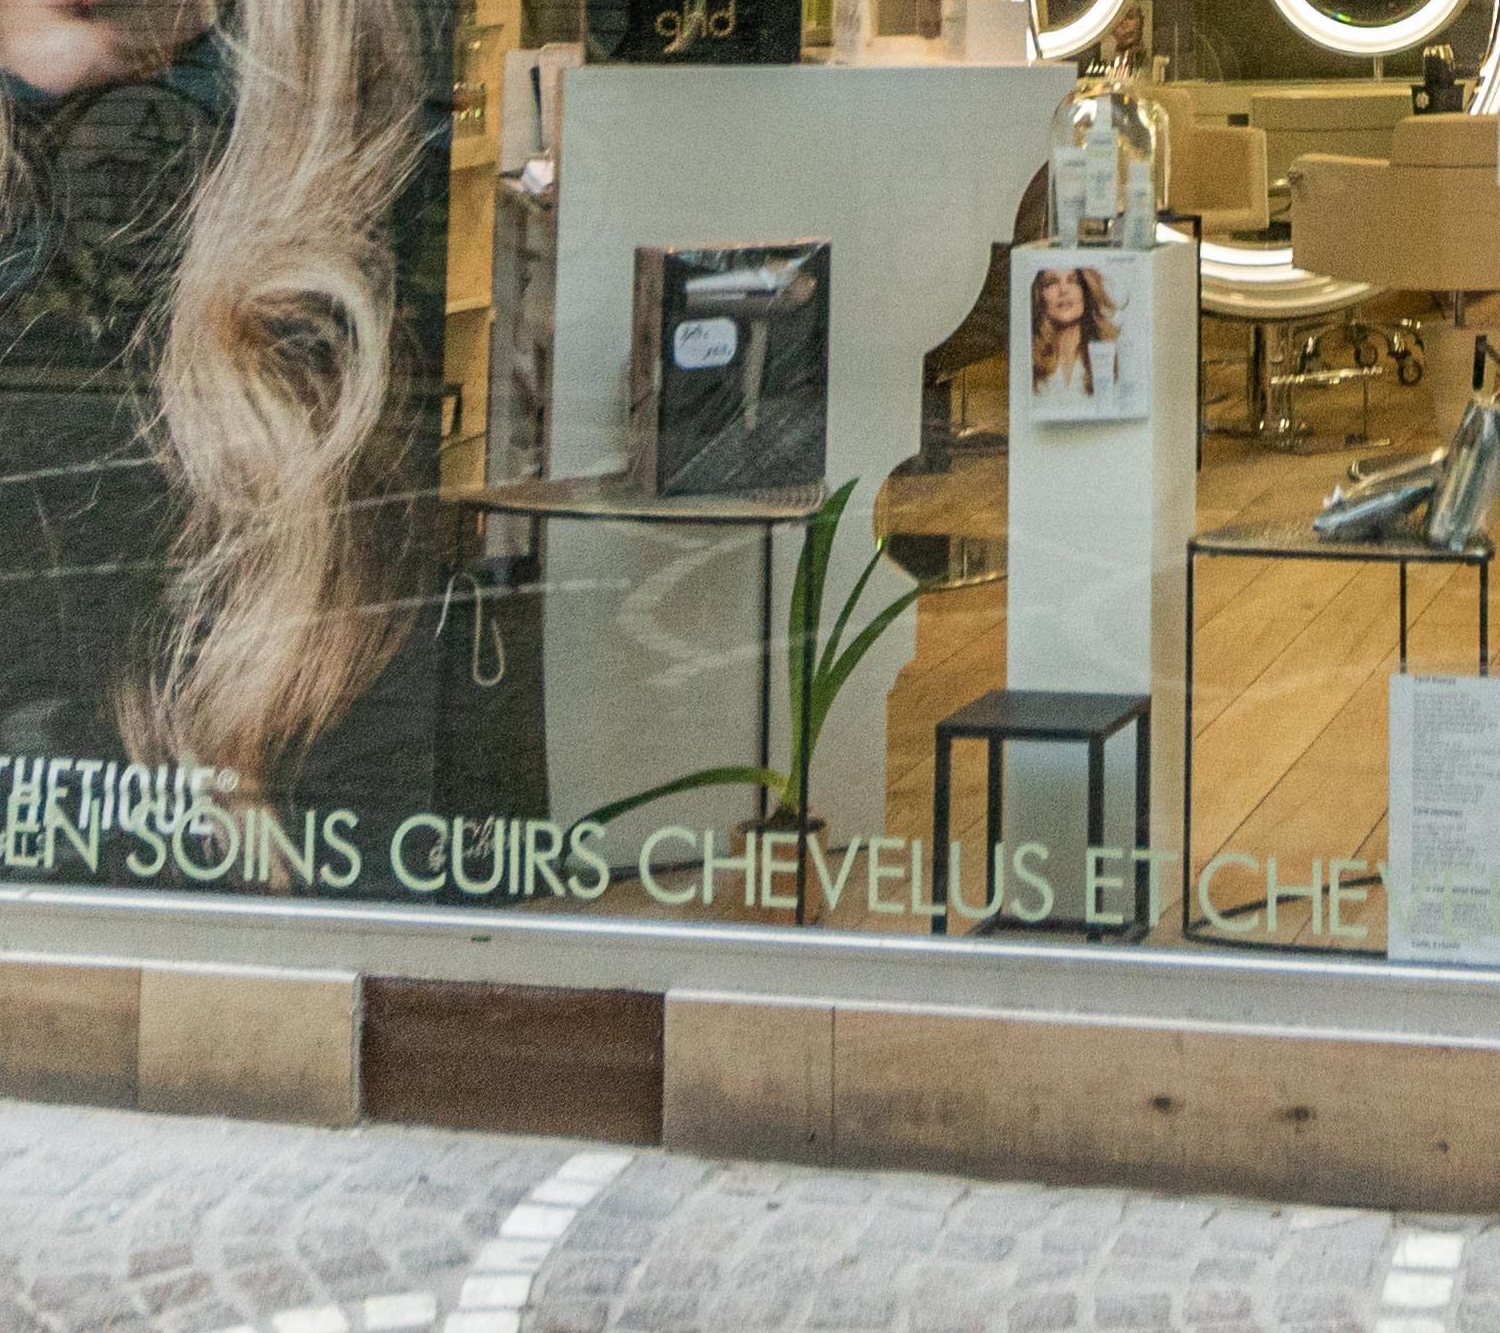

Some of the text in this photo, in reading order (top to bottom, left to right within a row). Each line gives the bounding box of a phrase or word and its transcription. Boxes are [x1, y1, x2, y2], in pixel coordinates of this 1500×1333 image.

[3, 787, 100, 874] EN
[125, 798, 363, 889] SOINS
[389, 811, 611, 900] CUIRS
[637, 825, 1056, 922] CHEVELUS
[1085, 845, 1179, 928] ET
